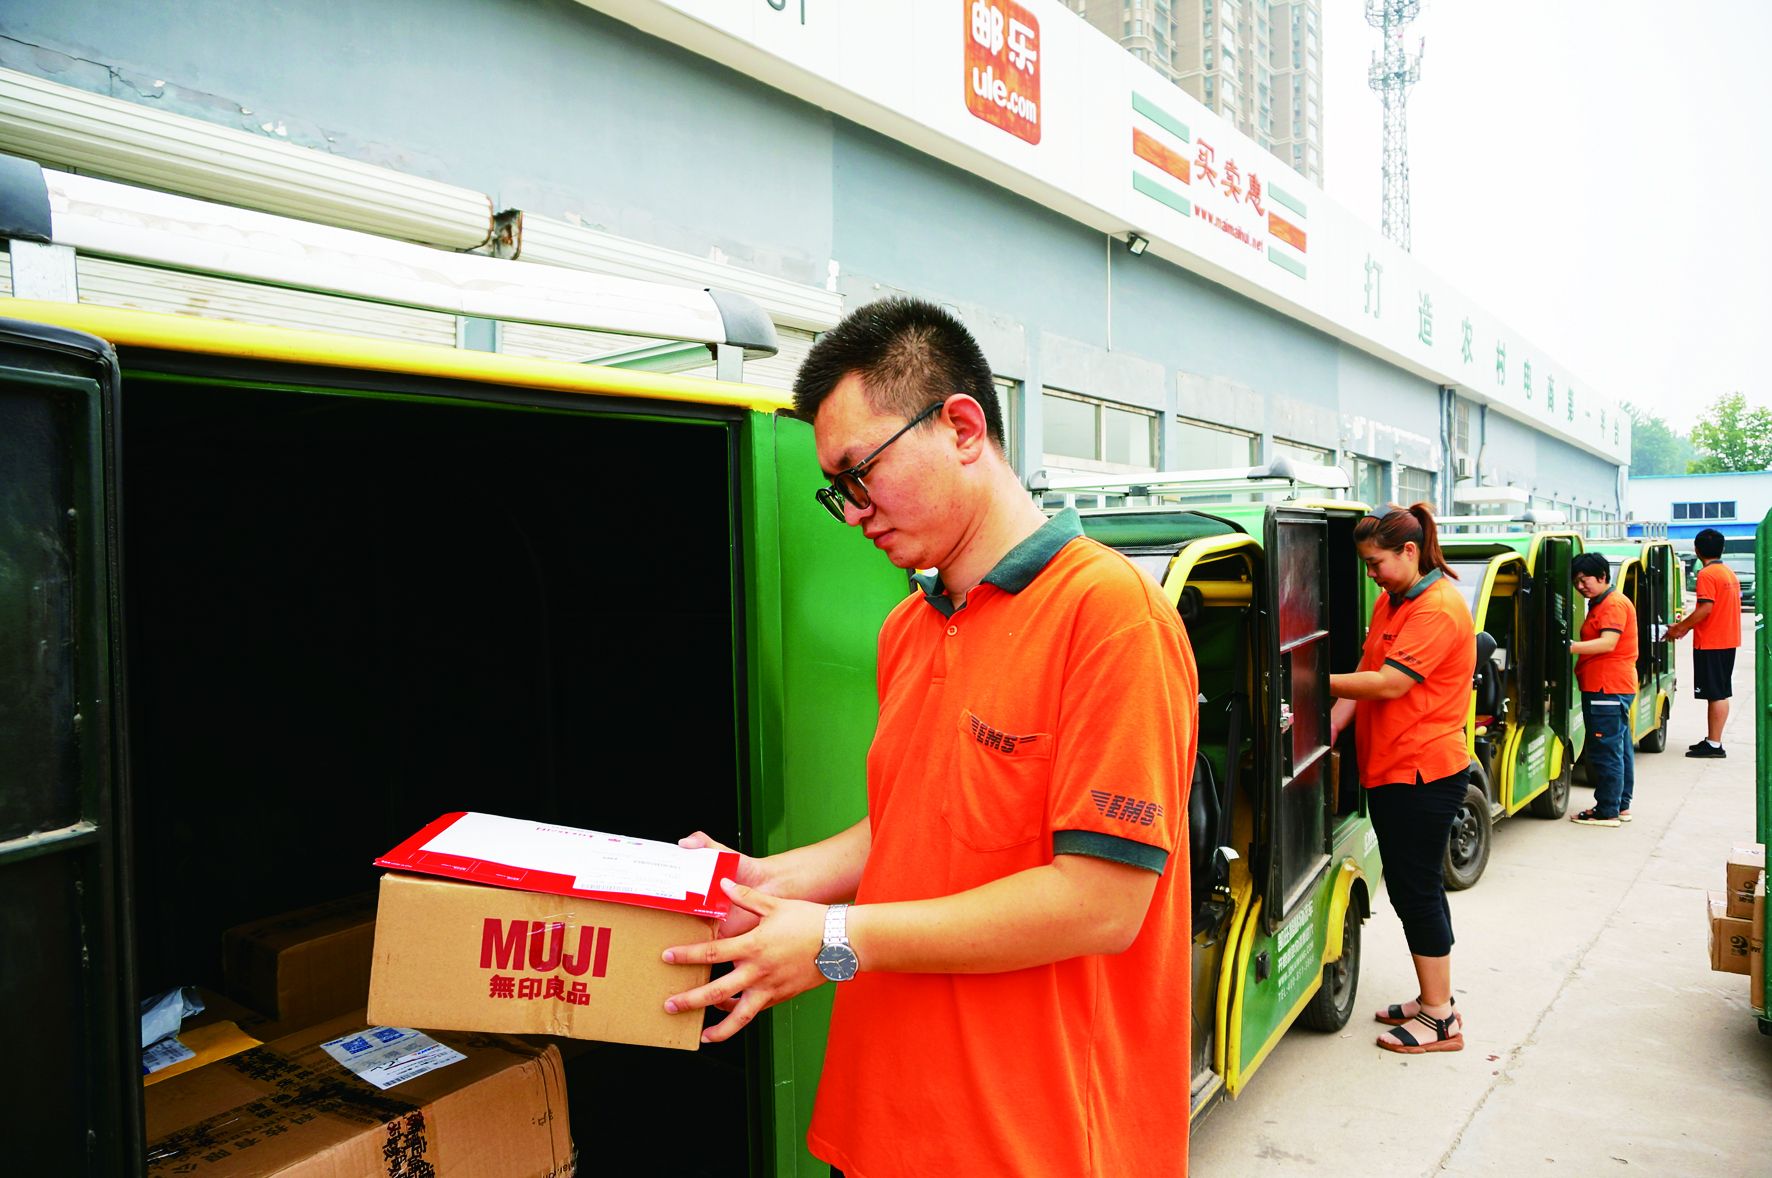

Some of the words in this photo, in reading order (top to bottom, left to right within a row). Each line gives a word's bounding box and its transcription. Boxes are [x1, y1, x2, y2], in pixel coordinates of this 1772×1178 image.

[971, 0, 1037, 75] 邮乐
[972, 65, 1037, 125] ule.com
[1194, 138, 1265, 217] 买卖惠
[969, 714, 1019, 754] EMS
[1094, 791, 1159, 828] EMS
[479, 918, 613, 978] MUJI
[488, 974, 592, 1007] 無印良品
